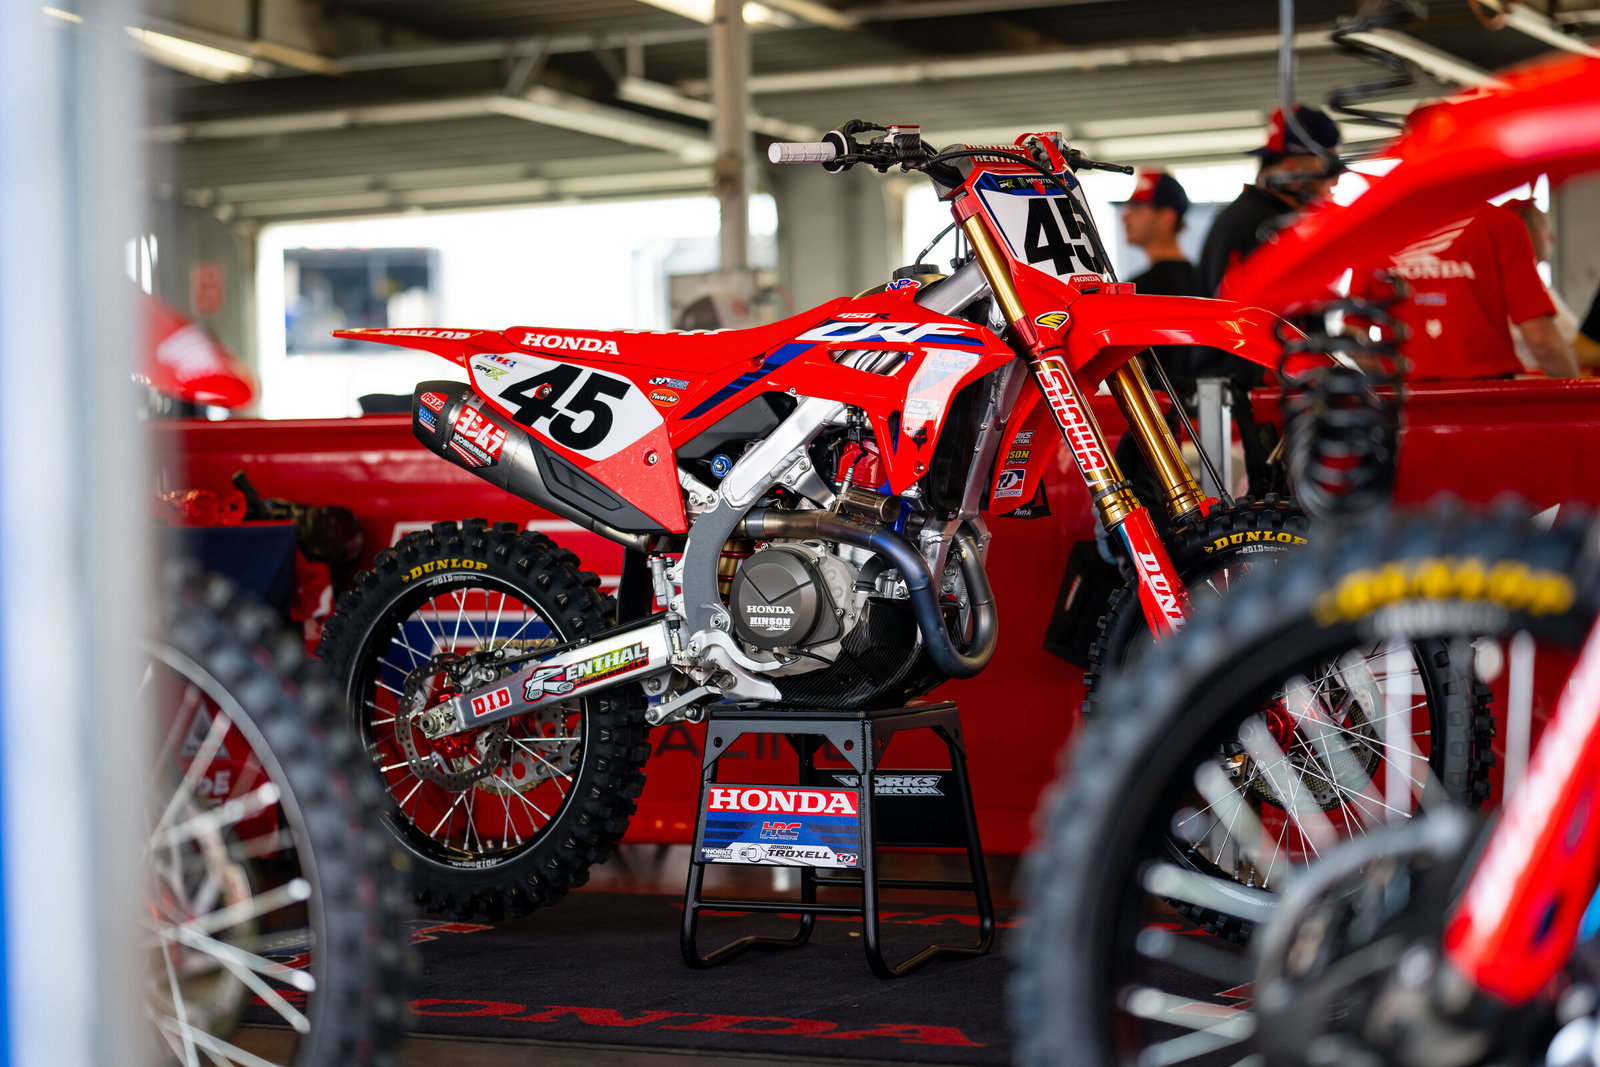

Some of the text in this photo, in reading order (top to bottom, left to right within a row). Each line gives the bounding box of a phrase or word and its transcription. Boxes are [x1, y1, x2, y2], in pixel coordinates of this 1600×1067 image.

[1024, 197, 1104, 276] 45
[794, 321, 976, 343] CRF
[520, 332, 620, 355] HONDA
[498, 363, 632, 451] 45
[651, 392, 679, 403] Twin Air
[1035, 368, 1108, 474] SHOWA
[1213, 530, 1309, 551] DUNLOP
[409, 558, 488, 580] DUNLOP
[746, 605, 795, 614] HONDA
[749, 616, 791, 626] HINSON
[709, 788, 857, 814] HONDA
[874, 786, 938, 794] NECTION
[760, 821, 802, 837] HRC
[767, 849, 831, 860] TROXELL
[405, 998, 987, 1048] ONDA
